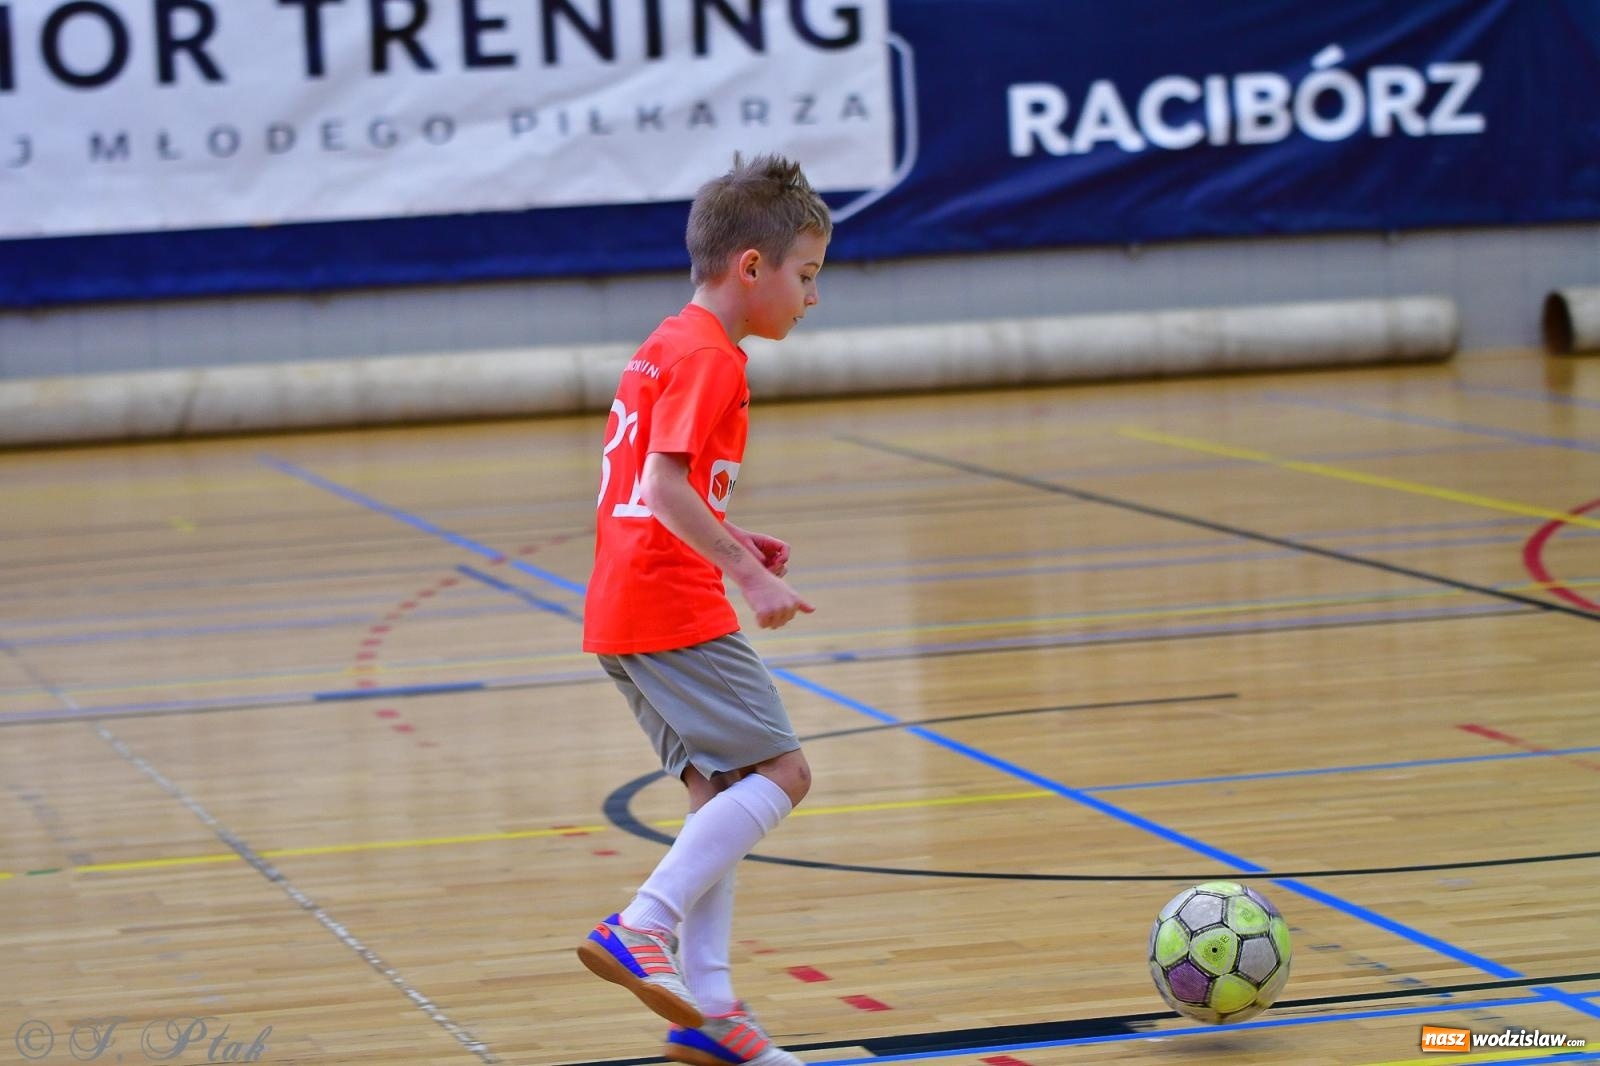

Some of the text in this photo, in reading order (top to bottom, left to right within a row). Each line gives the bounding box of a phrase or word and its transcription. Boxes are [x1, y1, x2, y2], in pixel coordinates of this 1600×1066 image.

[277, 0, 863, 78] TRENING
[88, 113, 457, 163] MŁODEGO
[510, 93, 871, 139] PIŁKARZA
[1007, 45, 1486, 157] RACIBÓRZ
